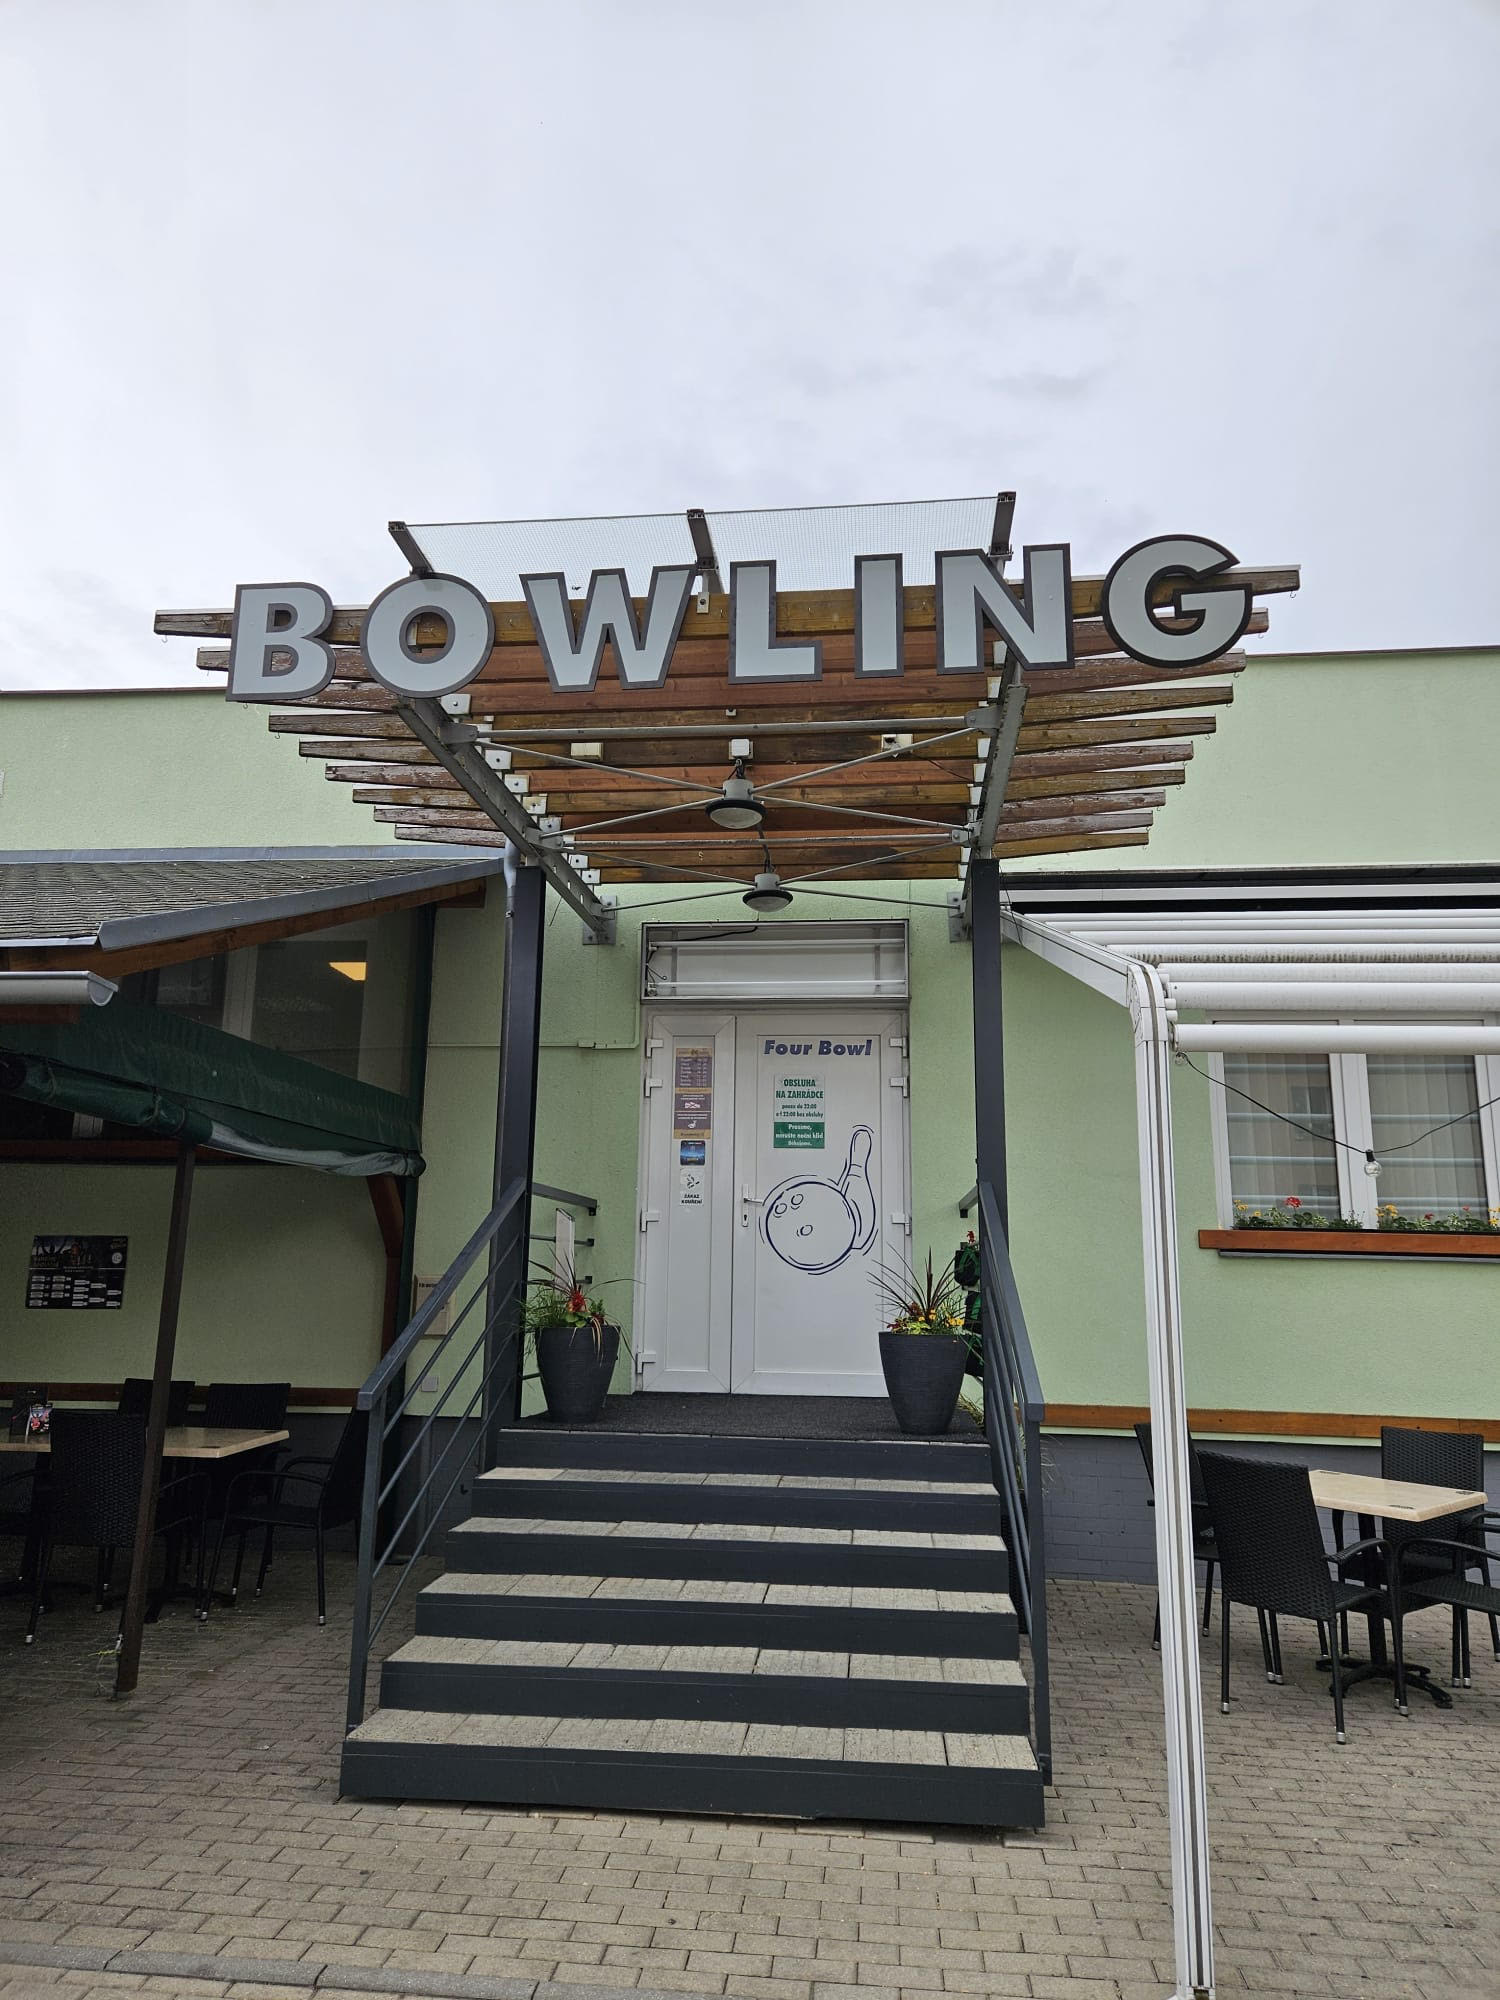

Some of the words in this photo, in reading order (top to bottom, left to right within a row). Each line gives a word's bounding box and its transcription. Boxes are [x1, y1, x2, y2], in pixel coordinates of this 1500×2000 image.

[226, 533, 1253, 701] BOWLING
[764, 1039, 813, 1056] Four
[818, 1039, 873, 1056] Bowl
[783, 1079, 816, 1087] OBSLUHA
[775, 1090, 786, 1099] NA
[788, 1089, 824, 1099] ZAHRÁDCE
